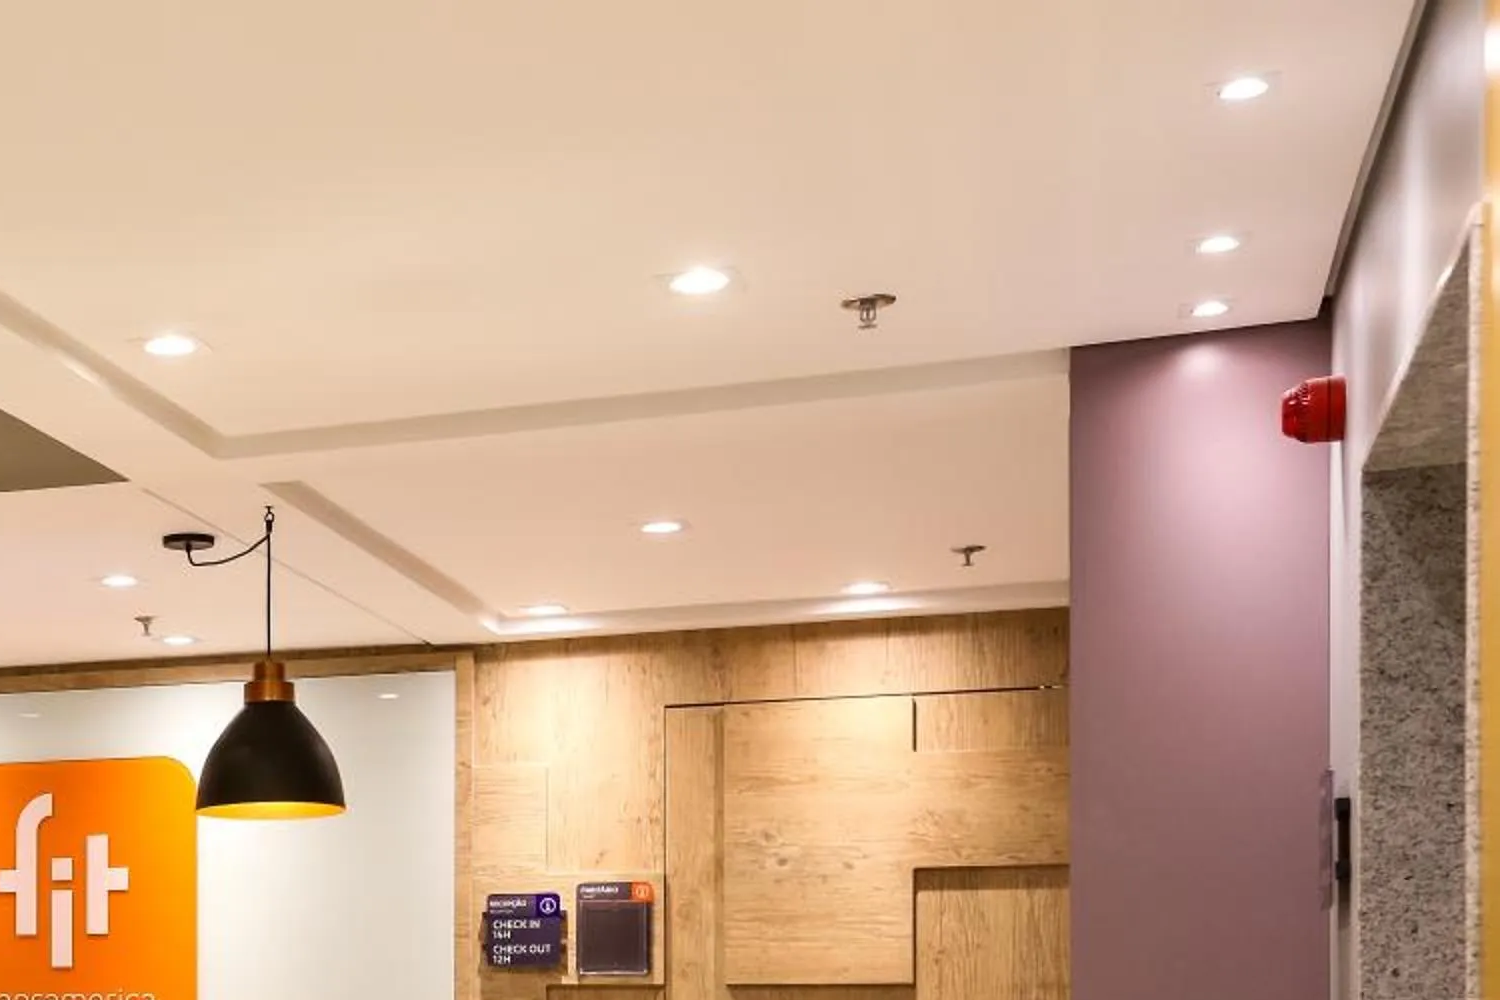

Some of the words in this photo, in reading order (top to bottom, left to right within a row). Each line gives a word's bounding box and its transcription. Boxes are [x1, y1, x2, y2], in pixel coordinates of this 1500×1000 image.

[493, 919, 527, 929] CHECK
[529, 919, 541, 929] IN
[493, 944, 527, 954] CHECK
[529, 943, 551, 954] OUT
[493, 954, 511, 965] 12H
